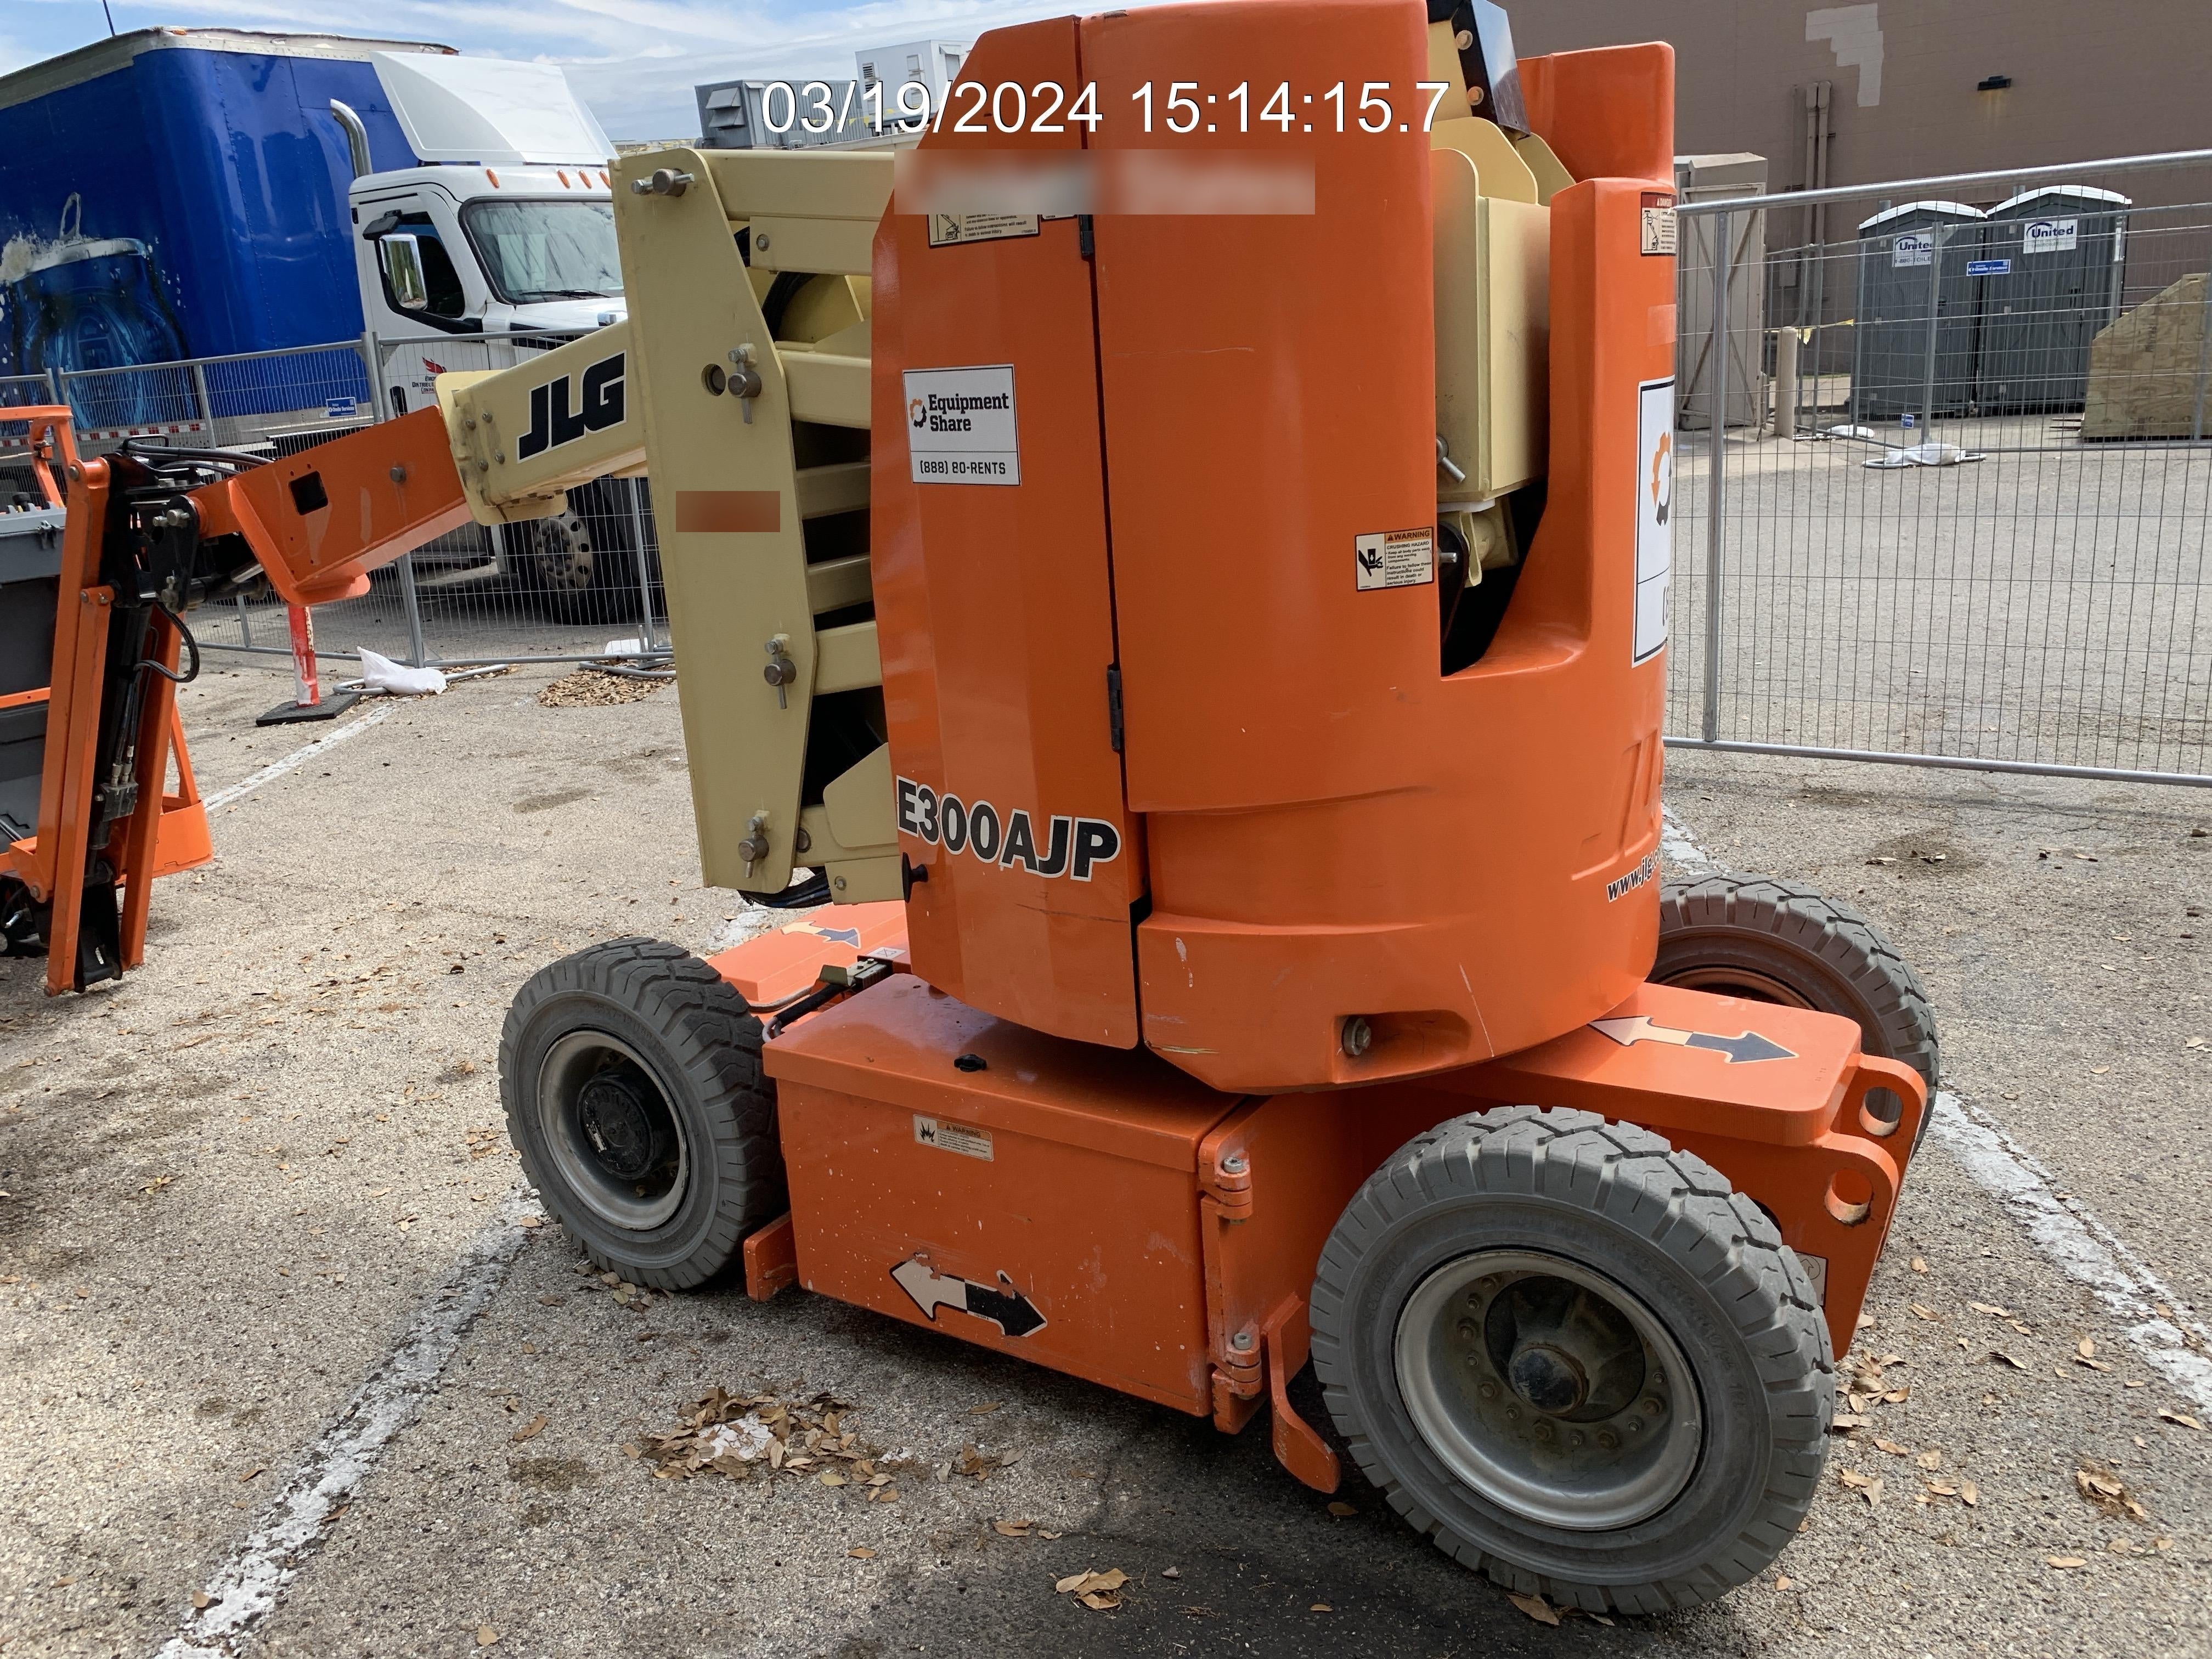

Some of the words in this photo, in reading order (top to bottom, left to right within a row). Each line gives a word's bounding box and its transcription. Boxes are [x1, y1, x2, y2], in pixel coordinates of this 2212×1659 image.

[2032, 225, 2074, 238] United
[1900, 241, 1932, 250] Unite
[517, 349, 627, 464] JLG
[928, 393, 1009, 414] Equipment
[930, 415, 972, 432] Share
[920, 460, 948, 475] (888)
[952, 461, 1006, 475] 80-RENTS
[1394, 530, 1430, 540] WARNING
[896, 775, 1121, 882] E300AJP
[1607, 839, 1662, 902] www.jlg.c
[952, 1125, 981, 1137] WARNING
